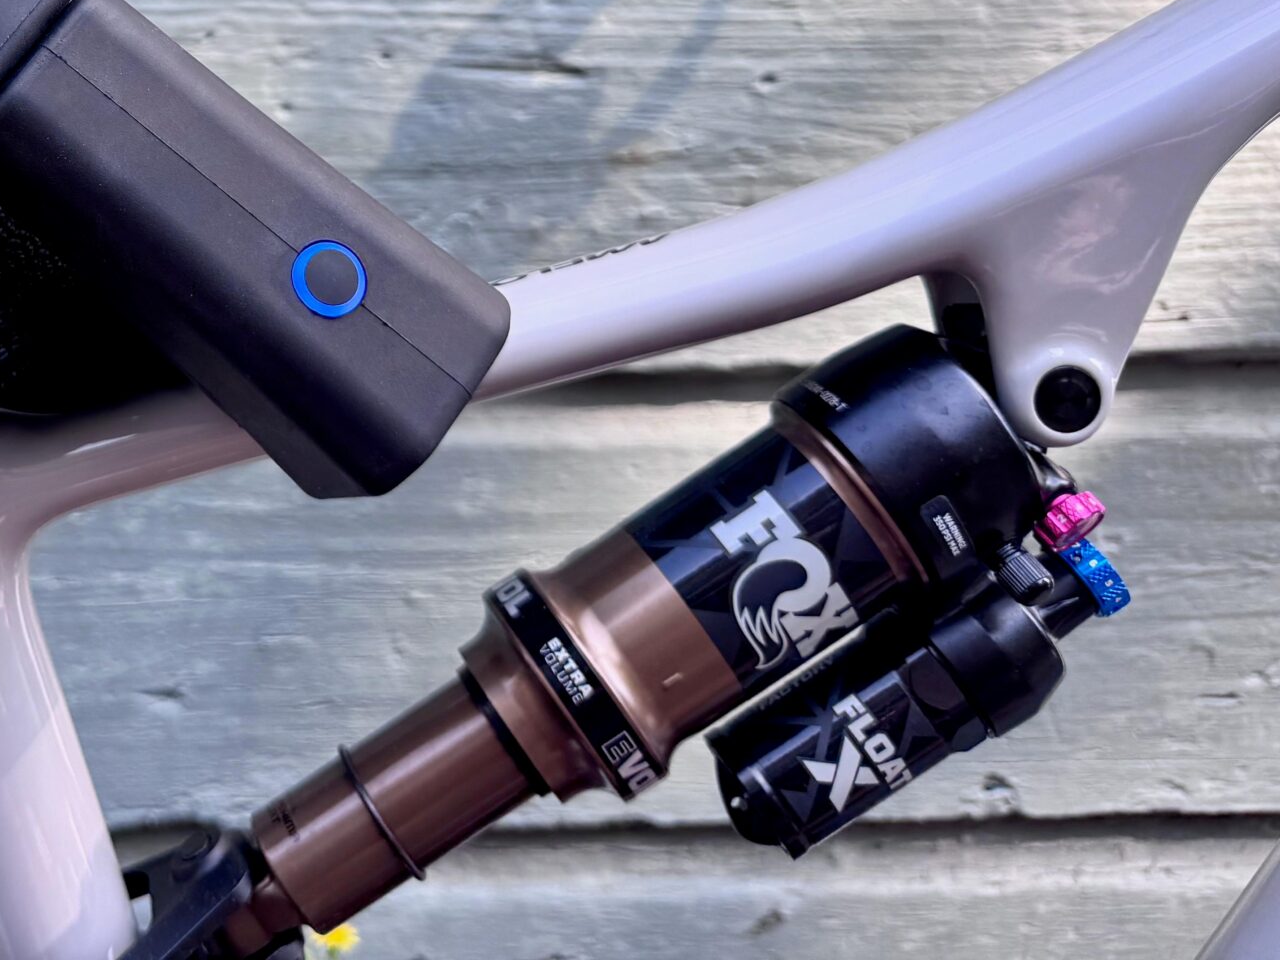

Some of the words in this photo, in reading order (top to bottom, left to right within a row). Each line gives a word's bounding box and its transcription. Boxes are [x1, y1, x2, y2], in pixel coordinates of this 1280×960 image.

[932, 515, 946, 531] 350
[941, 529, 953, 542] PSI
[947, 540, 961, 556] MAX
[943, 512, 967, 549] WARNING!
[710, 490, 860, 670] FOX
[539, 644, 584, 706] VOLUME
[547, 637, 594, 701] EXTRA
[758, 654, 834, 710] FACTORY
[832, 694, 913, 789] FLOAT
[801, 736, 879, 813] X
